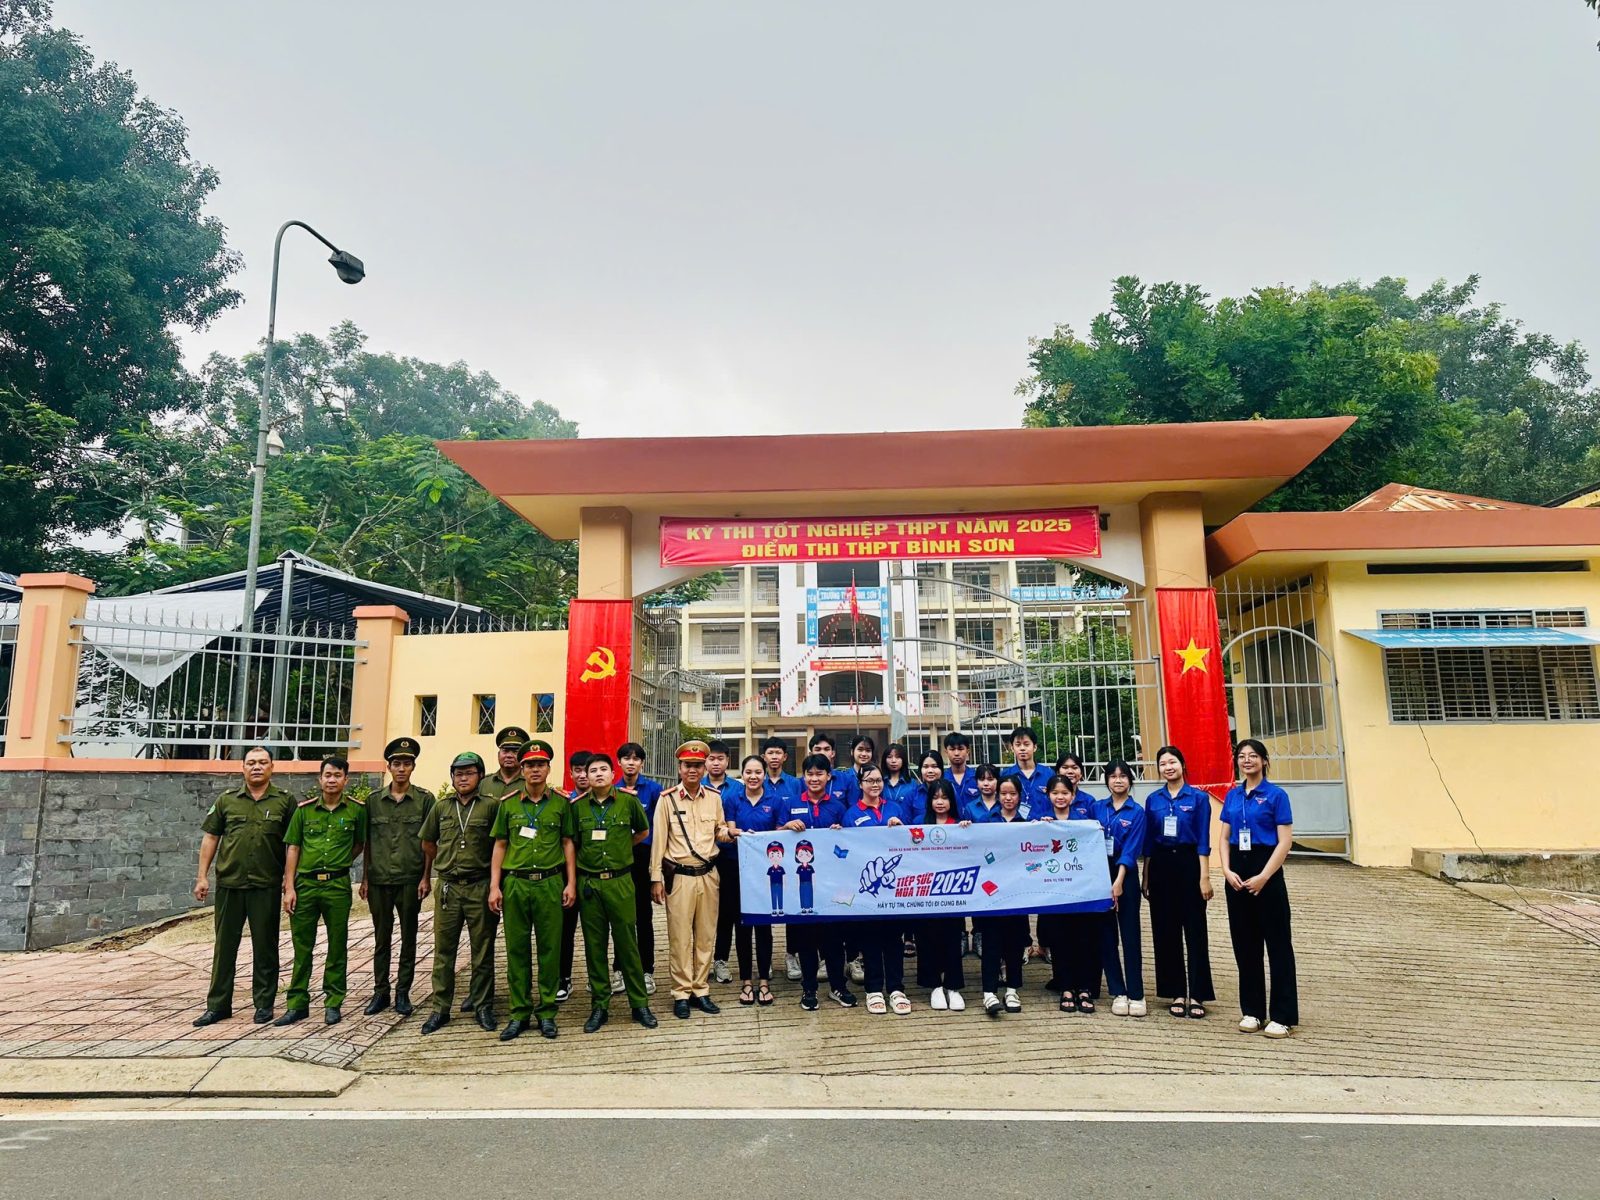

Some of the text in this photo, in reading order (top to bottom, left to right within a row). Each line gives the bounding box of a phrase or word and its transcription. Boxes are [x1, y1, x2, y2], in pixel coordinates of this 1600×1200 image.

[687, 518, 1072, 540] KỲ THI TỐT NGHIỆP THPT NĂM 2025
[742, 537, 1015, 558] ĐIỂM THI THPT BÌNH SƠN
[1020, 841, 1033, 852] UR
[1067, 840, 1078, 851] C2
[1063, 859, 1083, 871] Oris
[897, 872, 934, 887] TIẾP SỨC
[931, 869, 977, 894] 2025
[916, 885, 930, 897] THI
